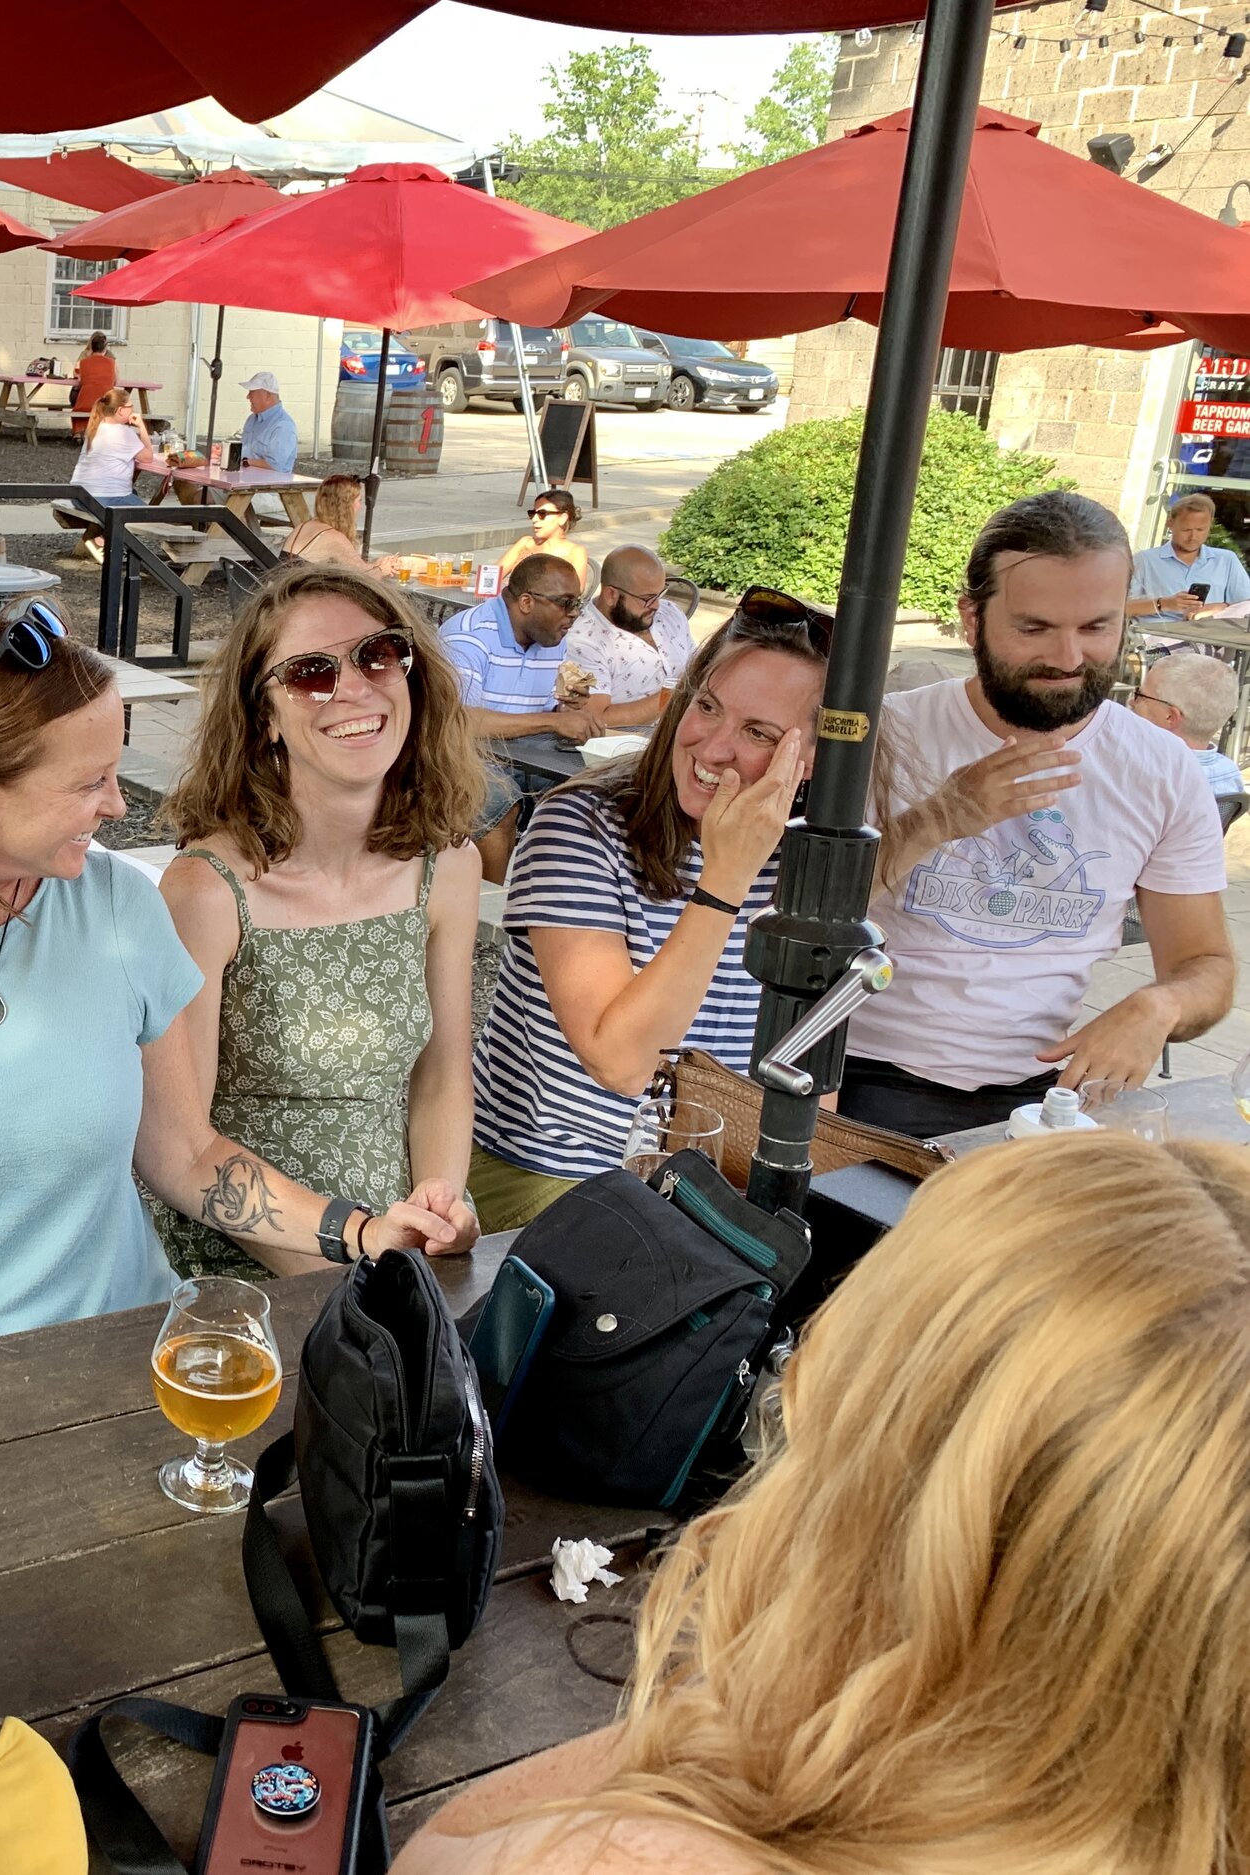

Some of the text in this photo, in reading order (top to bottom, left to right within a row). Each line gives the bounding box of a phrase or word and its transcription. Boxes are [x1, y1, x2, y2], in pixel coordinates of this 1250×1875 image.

[1195, 357, 1250, 379] ARD
[1201, 380, 1245, 391] CRAFT
[1195, 404, 1250, 420] TAPROOM
[1192, 418, 1250, 435] BEER GAR
[1013, 892, 1094, 929] PARK
